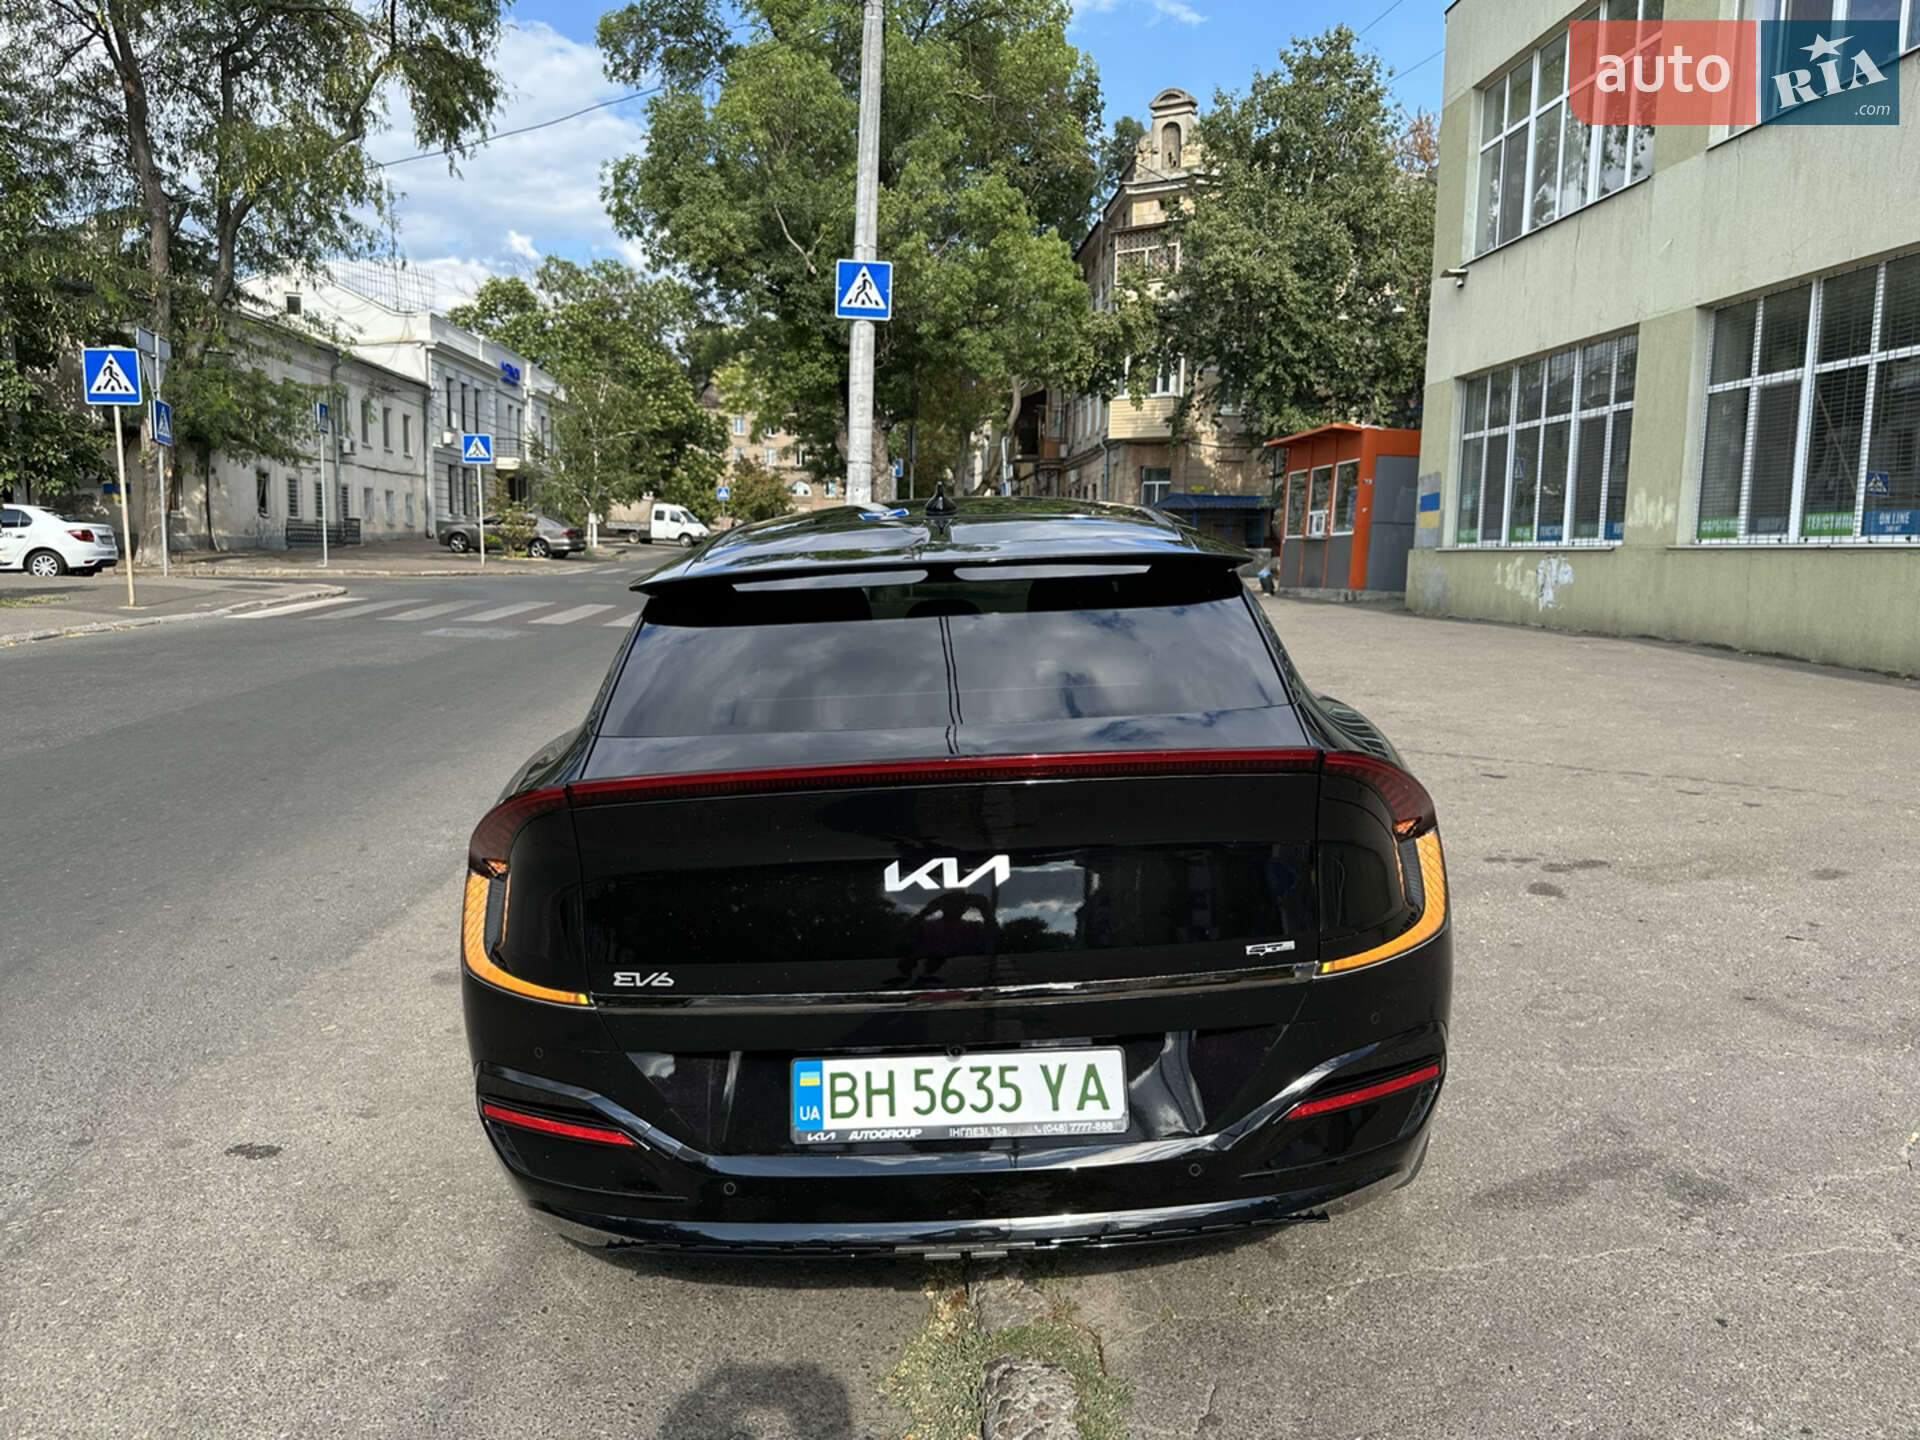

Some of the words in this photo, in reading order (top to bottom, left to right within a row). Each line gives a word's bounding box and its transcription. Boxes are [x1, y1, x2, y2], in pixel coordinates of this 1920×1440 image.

[613, 972, 674, 987] EV6
[829, 1070, 895, 1119] BH
[913, 1065, 1022, 1115] 5635
[1039, 1063, 1110, 1111] YA
[800, 1105, 821, 1121] UA
[848, 1128, 922, 1141] AUTOGROUP
